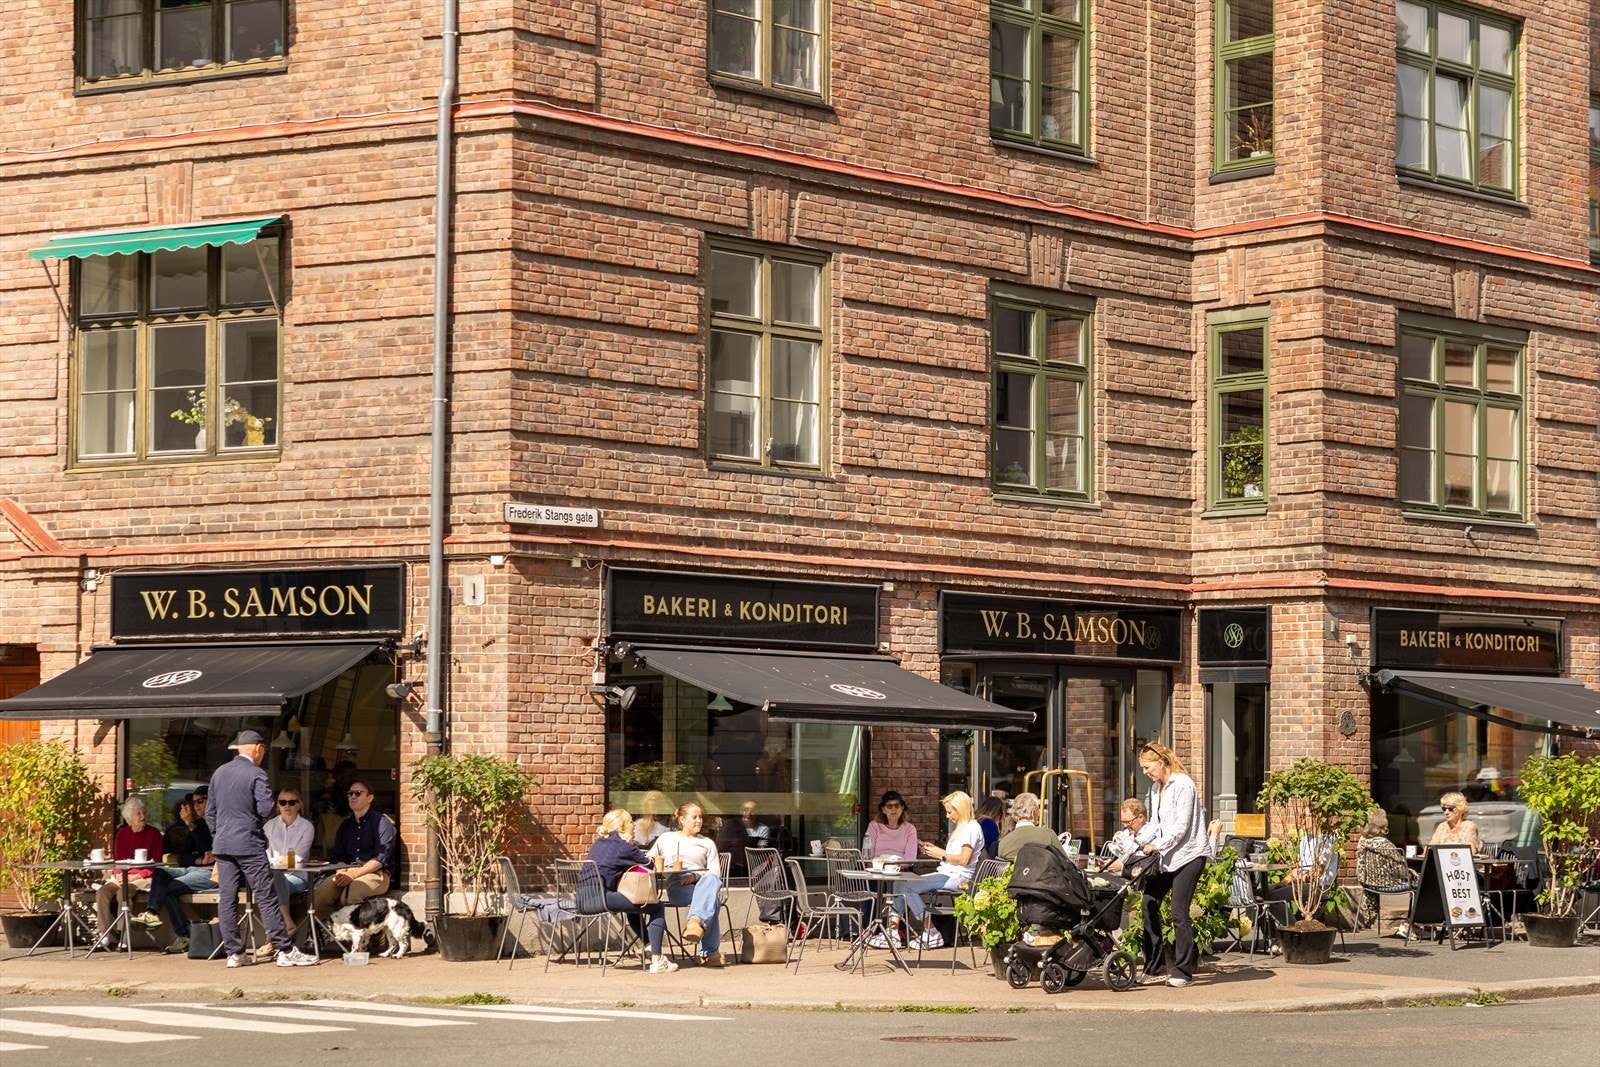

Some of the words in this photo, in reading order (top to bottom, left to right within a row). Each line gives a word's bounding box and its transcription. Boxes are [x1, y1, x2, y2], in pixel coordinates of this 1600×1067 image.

[509, 506, 543, 520] Frederik
[545, 509, 573, 524] Stangs
[575, 511, 594, 525] gate
[140, 590, 179, 620] W.
[187, 589, 215, 619] B.
[223, 584, 374, 618] SAMSON
[643, 594, 717, 618] BAKERI
[724, 603, 733, 617] &
[740, 600, 848, 625] KONDITORI
[979, 609, 1010, 638] W.
[1016, 612, 1037, 639] B.
[1043, 613, 1147, 646] SAMSON
[1400, 629, 1450, 649] BAKERI
[1454, 635, 1462, 647] &
[1465, 632, 1540, 653] KONDITORI
[1446, 869, 1471, 882] HØST
[1451, 888, 1471, 899] BEST
